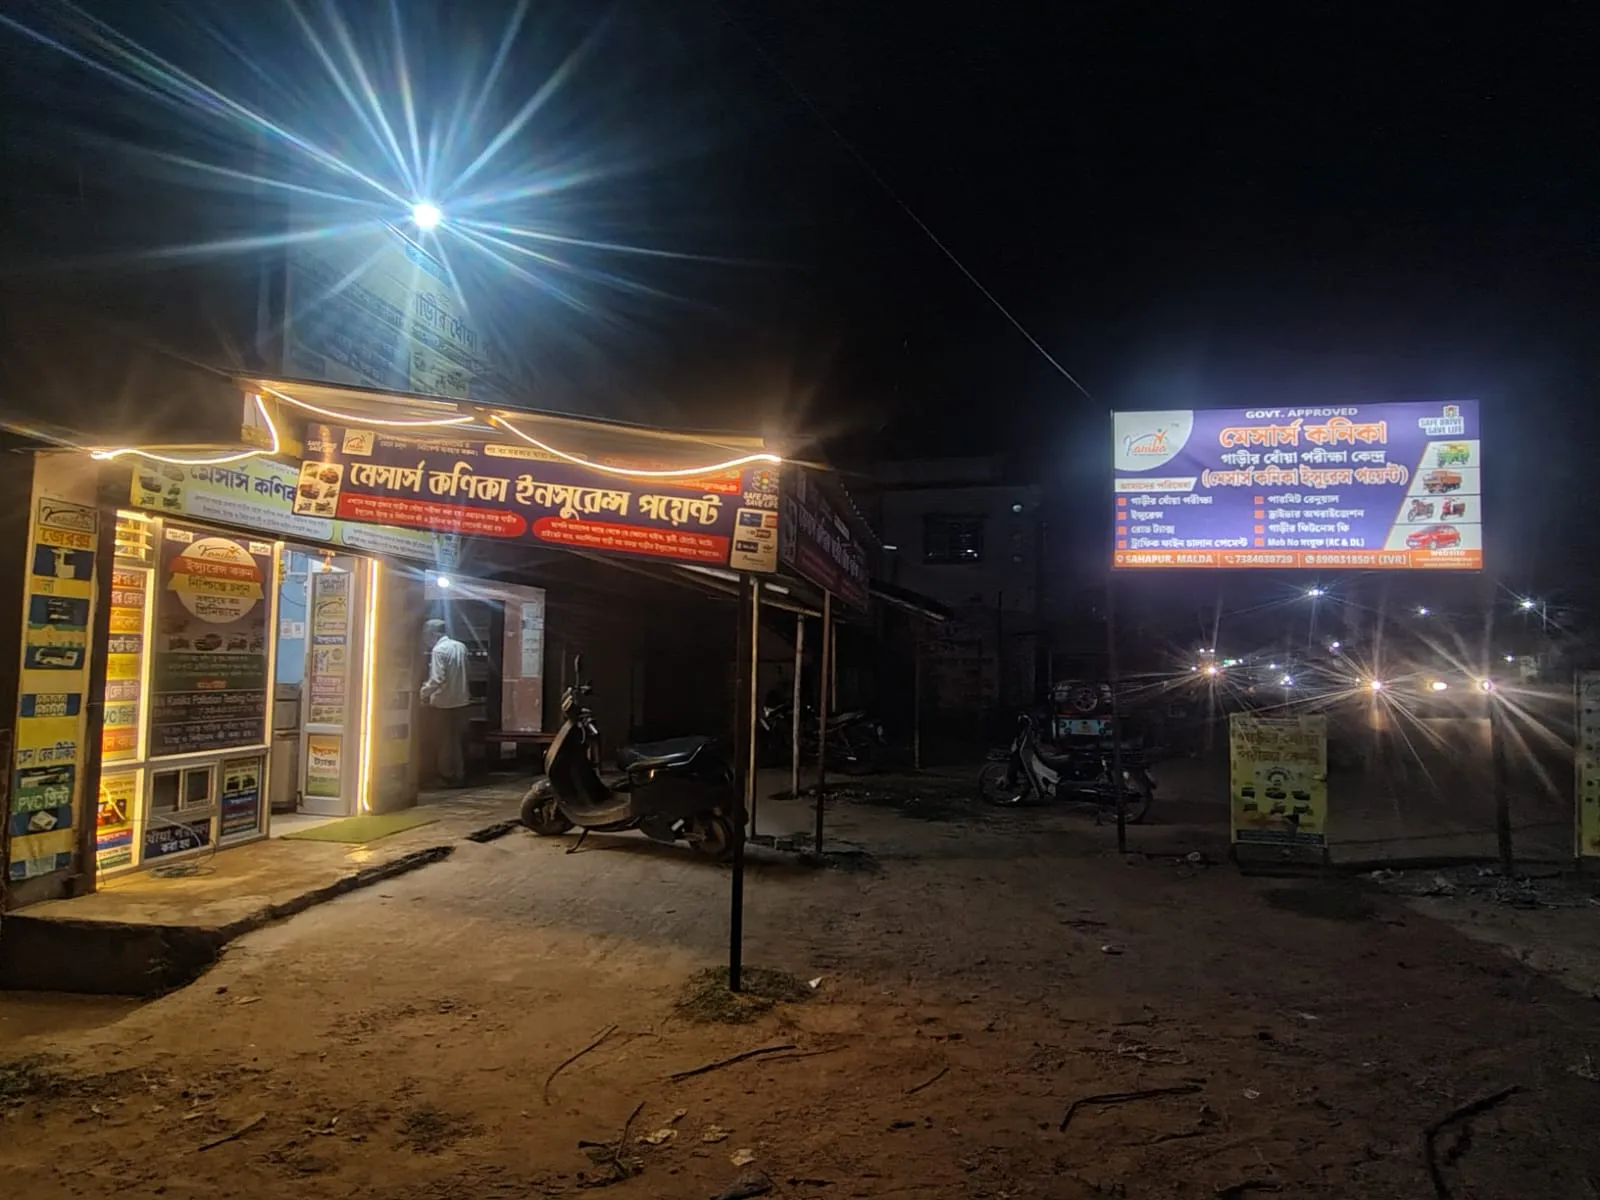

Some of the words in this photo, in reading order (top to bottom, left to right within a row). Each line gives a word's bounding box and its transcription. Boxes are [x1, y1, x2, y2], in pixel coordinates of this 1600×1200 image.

[1246, 410, 1284, 419] GOVT.
[1288, 408, 1358, 417] APPROVED
[1219, 419, 1303, 448] মেসার্স
[1304, 417, 1387, 445] কনিকা
[1301, 447, 1347, 463] পরীক্ষা
[190, 464, 250, 493] মেসার্স
[351, 460, 426, 493] মেসার্স
[429, 461, 510, 503] কণিকা
[515, 474, 632, 521] ইনসুরেন্স
[638, 494, 723, 527] পয়েন্ট
[1177, 555, 1214, 564] MALDA
[18, 794, 44, 813] PVC
